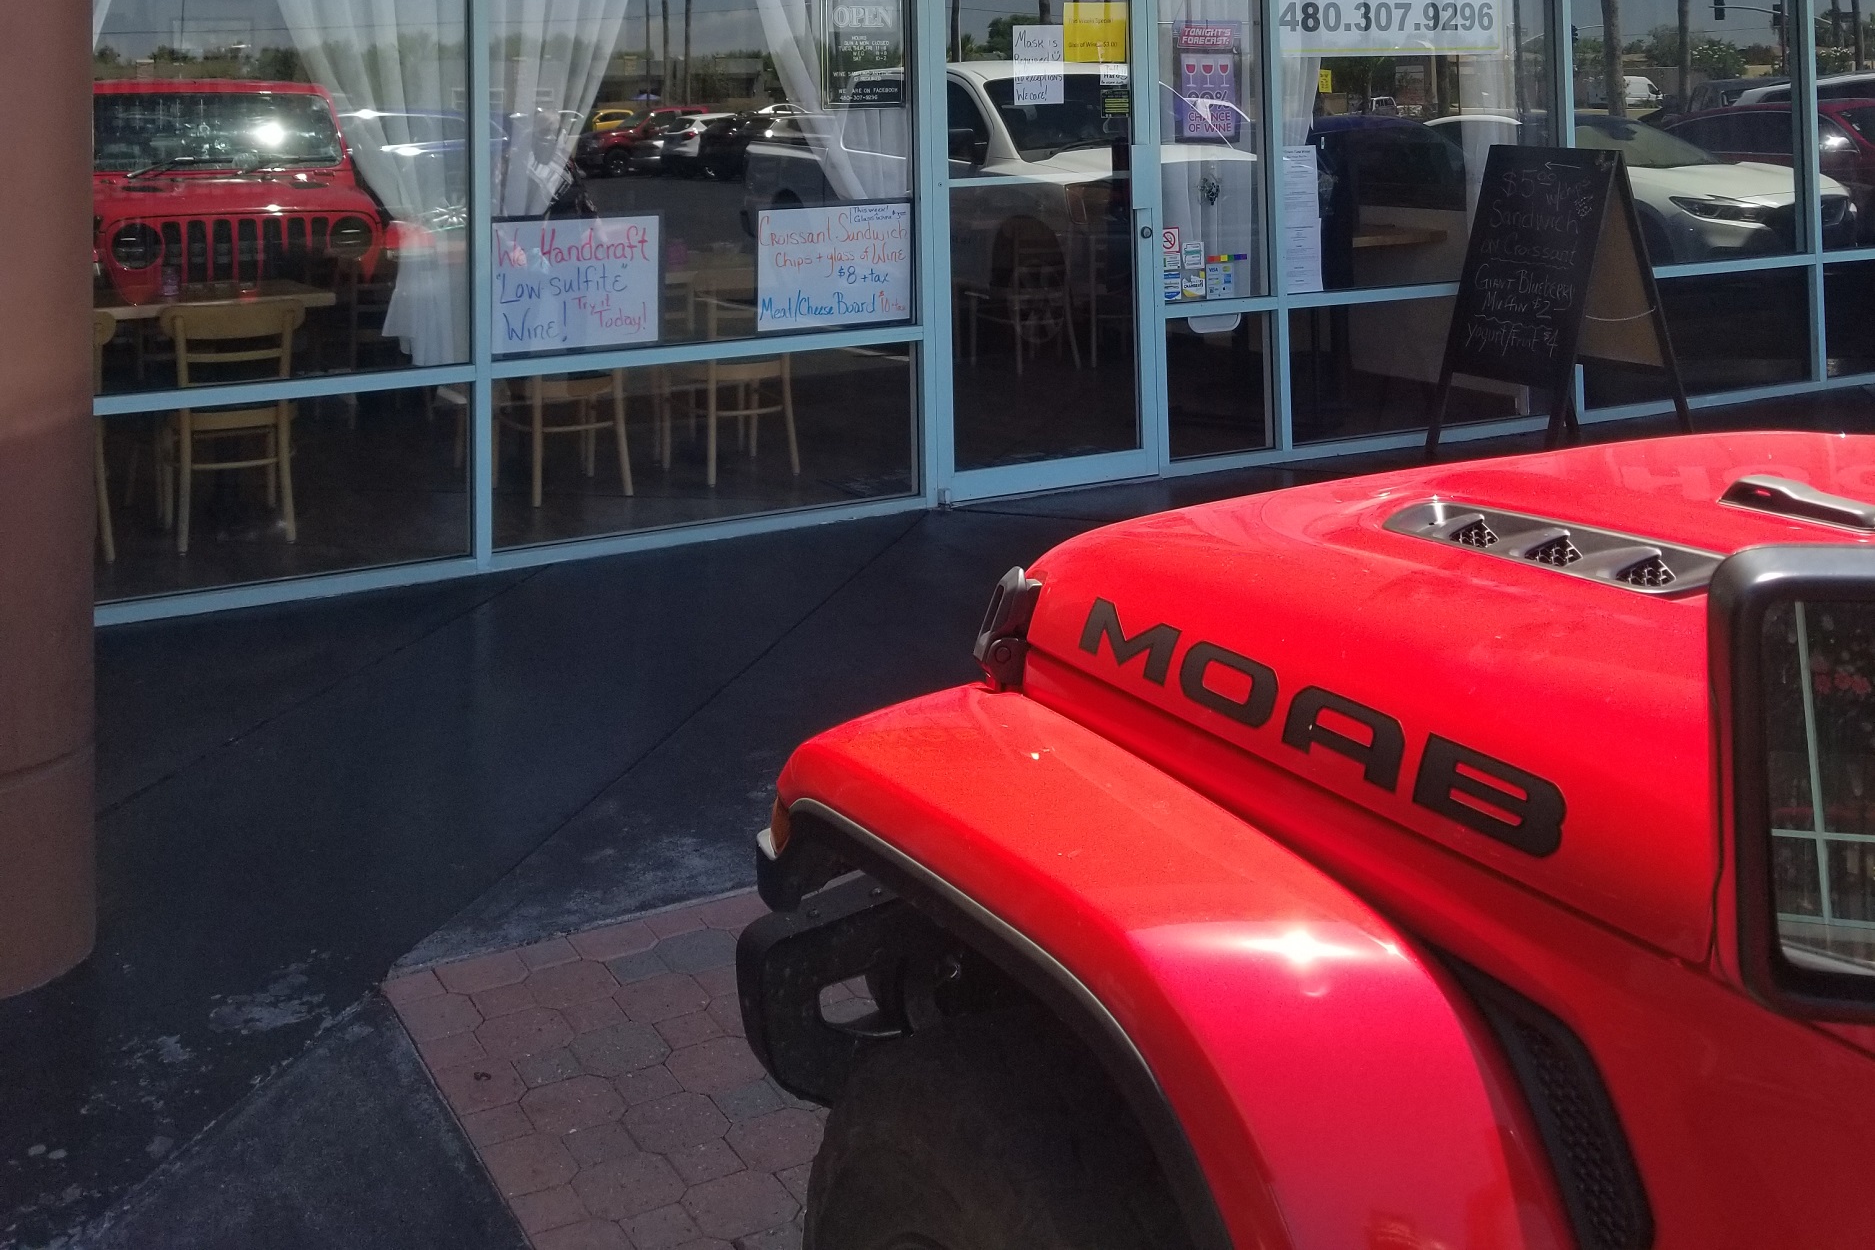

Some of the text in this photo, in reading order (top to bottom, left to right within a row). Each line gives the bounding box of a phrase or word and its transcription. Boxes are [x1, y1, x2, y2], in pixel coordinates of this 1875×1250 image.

[832, 4, 895, 29] OPEN
[1278, 1, 1494, 33] 480.307.9296
[1015, 29, 1045, 49] Mask
[1184, 27, 1231, 37] TONIGHT'S
[1188, 112, 1231, 122] CHNCE
[1188, 122, 1232, 133] OF WINE
[838, 213, 908, 243] Sandwich
[539, 225, 650, 268] Handcraft
[775, 251, 813, 275] Chips
[838, 265, 858, 285] $8
[1077, 596, 1568, 859] MOAB
